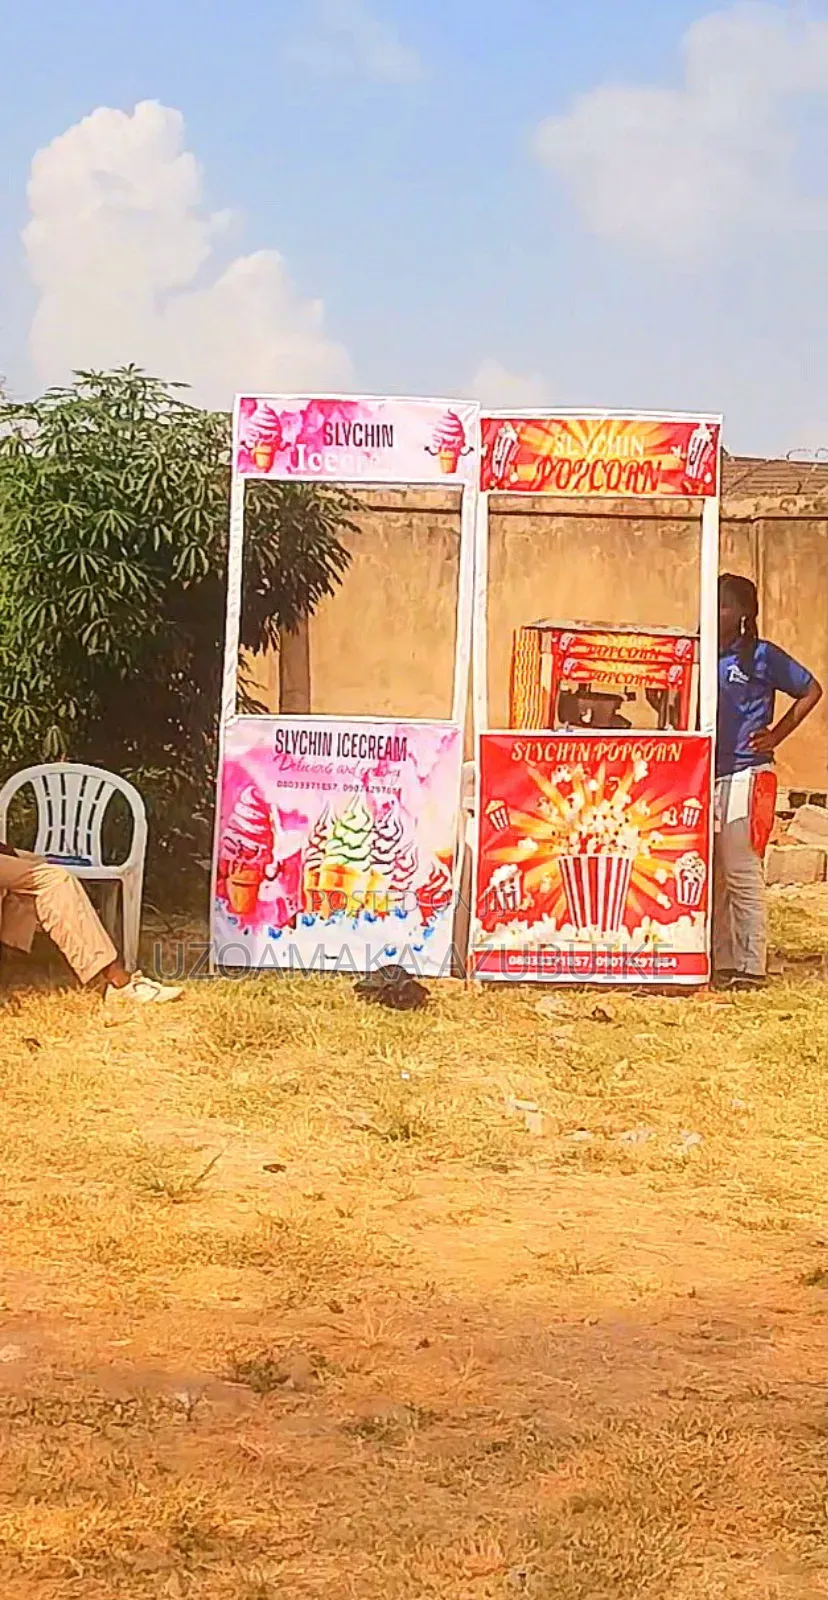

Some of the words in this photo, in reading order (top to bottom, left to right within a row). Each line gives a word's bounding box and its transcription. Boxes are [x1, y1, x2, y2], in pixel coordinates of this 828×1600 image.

[323, 421, 394, 448] SLYCHIN
[554, 434, 646, 458] SLYCHIN
[534, 458, 663, 494] POPCORN
[274, 728, 333, 757] SLYCHIN
[336, 732, 408, 762] ICECREAM
[511, 741, 591, 762] SLYCHIN
[593, 741, 683, 763] POPCORN
